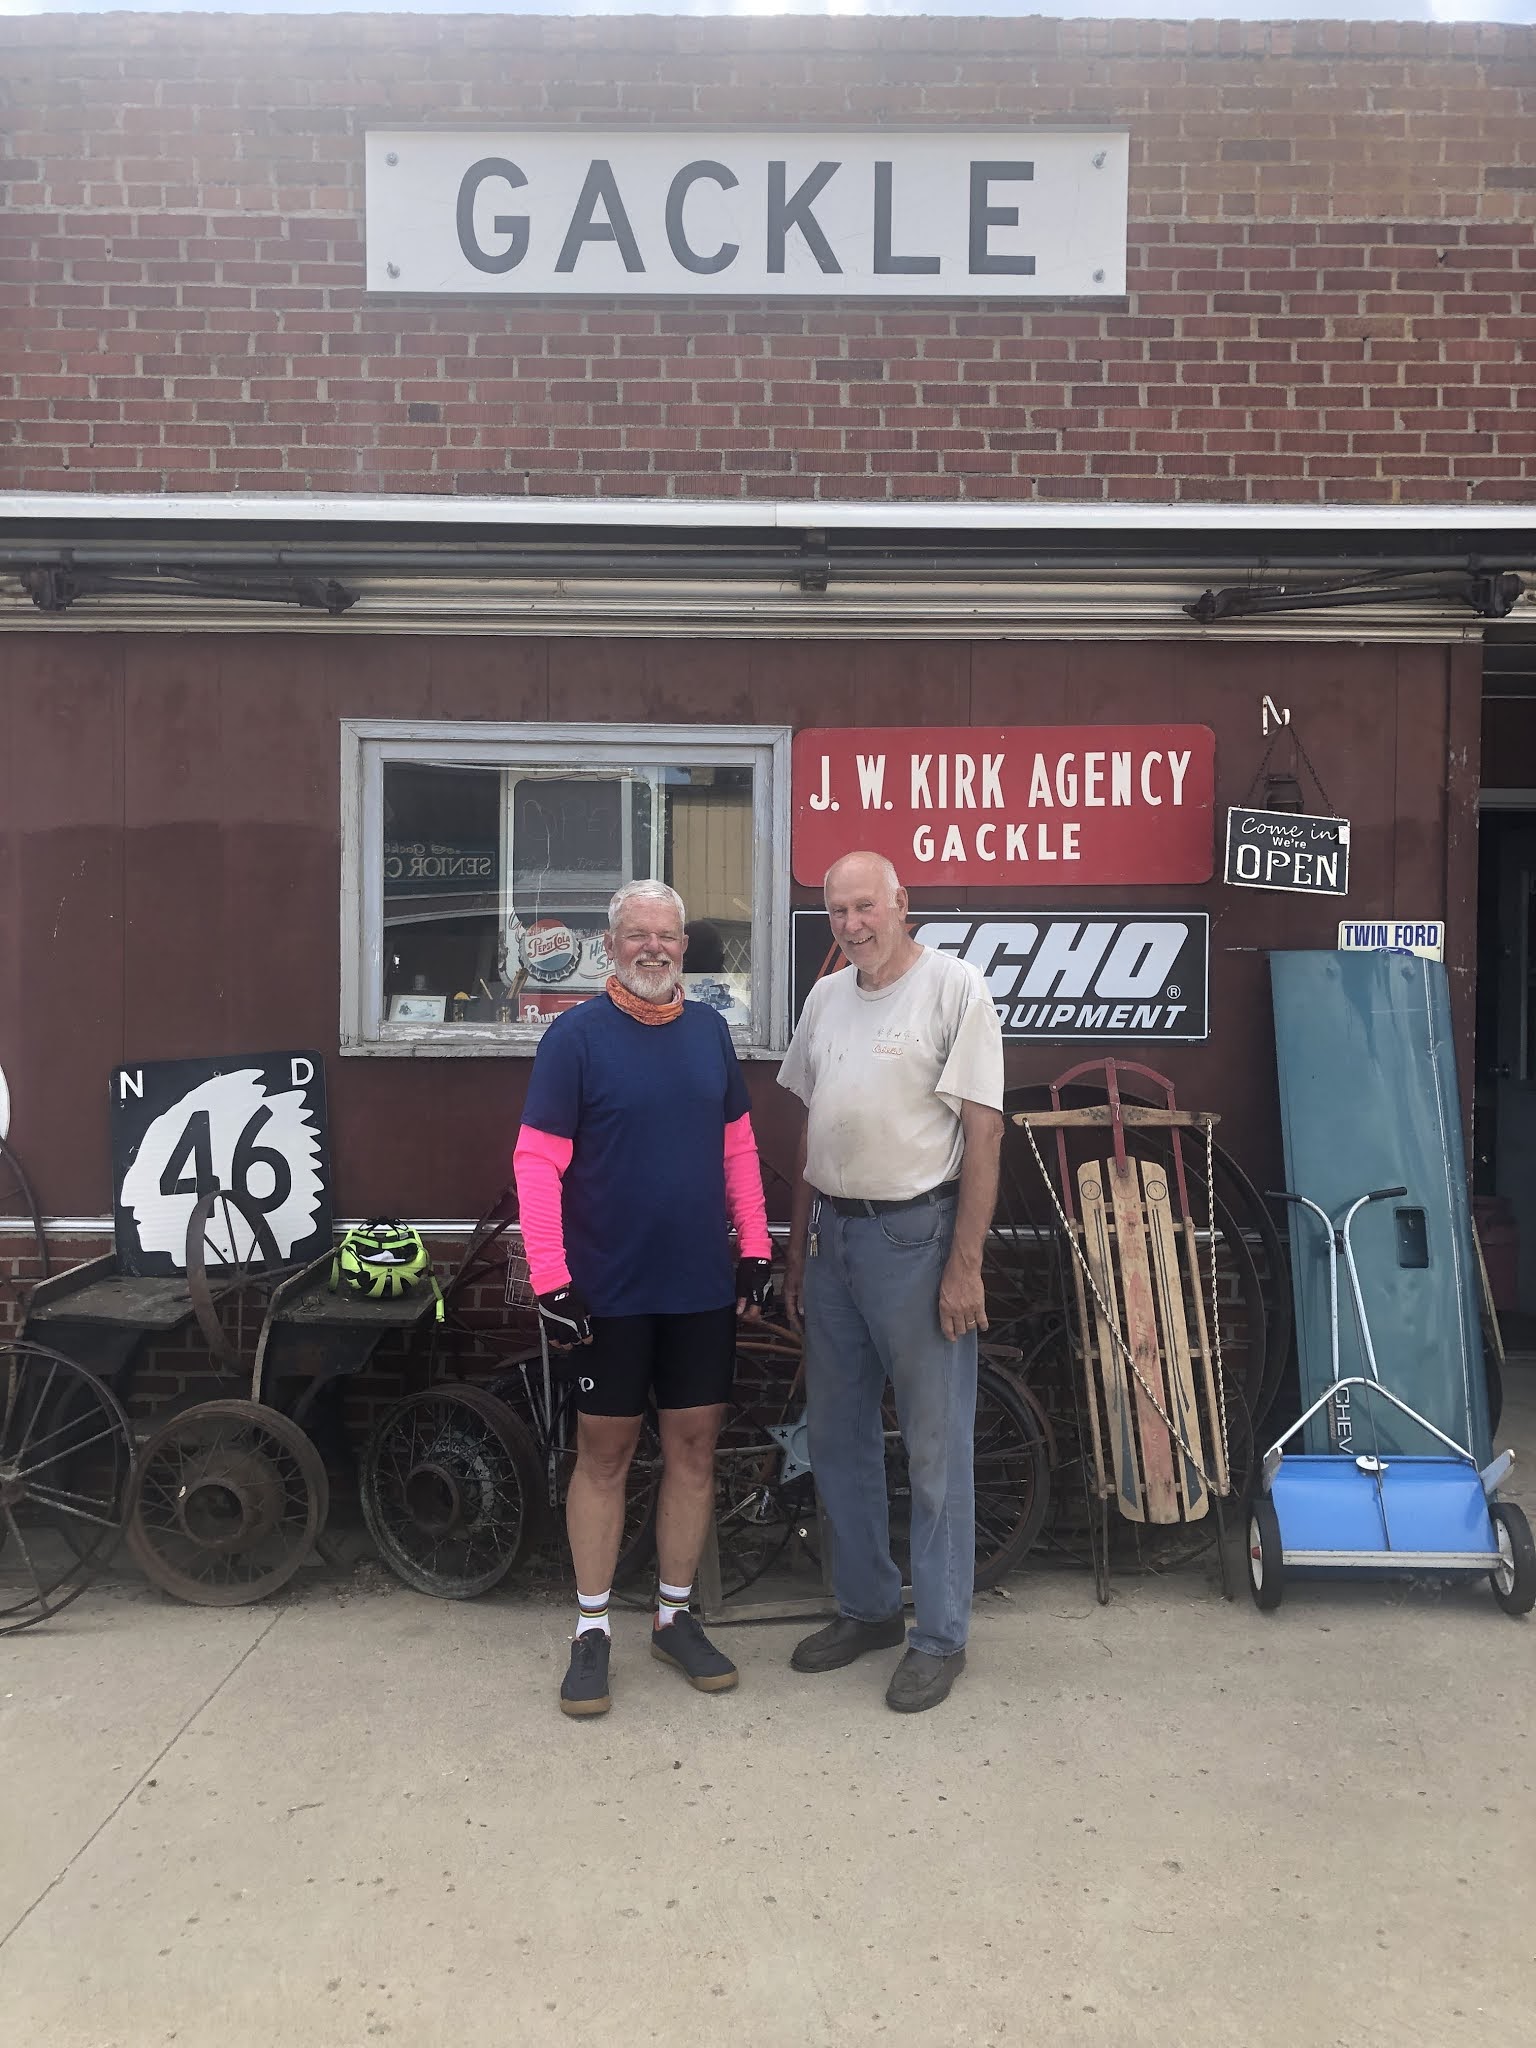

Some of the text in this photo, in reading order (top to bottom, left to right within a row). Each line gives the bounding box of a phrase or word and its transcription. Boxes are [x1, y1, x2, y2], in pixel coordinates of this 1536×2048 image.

[456, 157, 1036, 274] GACKLE
[809, 750, 1192, 811] J. W. KIRK AGENCY
[913, 823, 1082, 862] GACKLE
[1241, 817, 1304, 838] Come
[1310, 823, 1338, 840] in
[1272, 836, 1307, 849] We're
[1236, 844, 1338, 887] OPEN
[1345, 925, 1438, 947] TWIN FORD
[994, 1004, 1187, 1028] QUIPMENT
[119, 1057, 315, 1099] N D
[159, 1105, 292, 1219] 46
